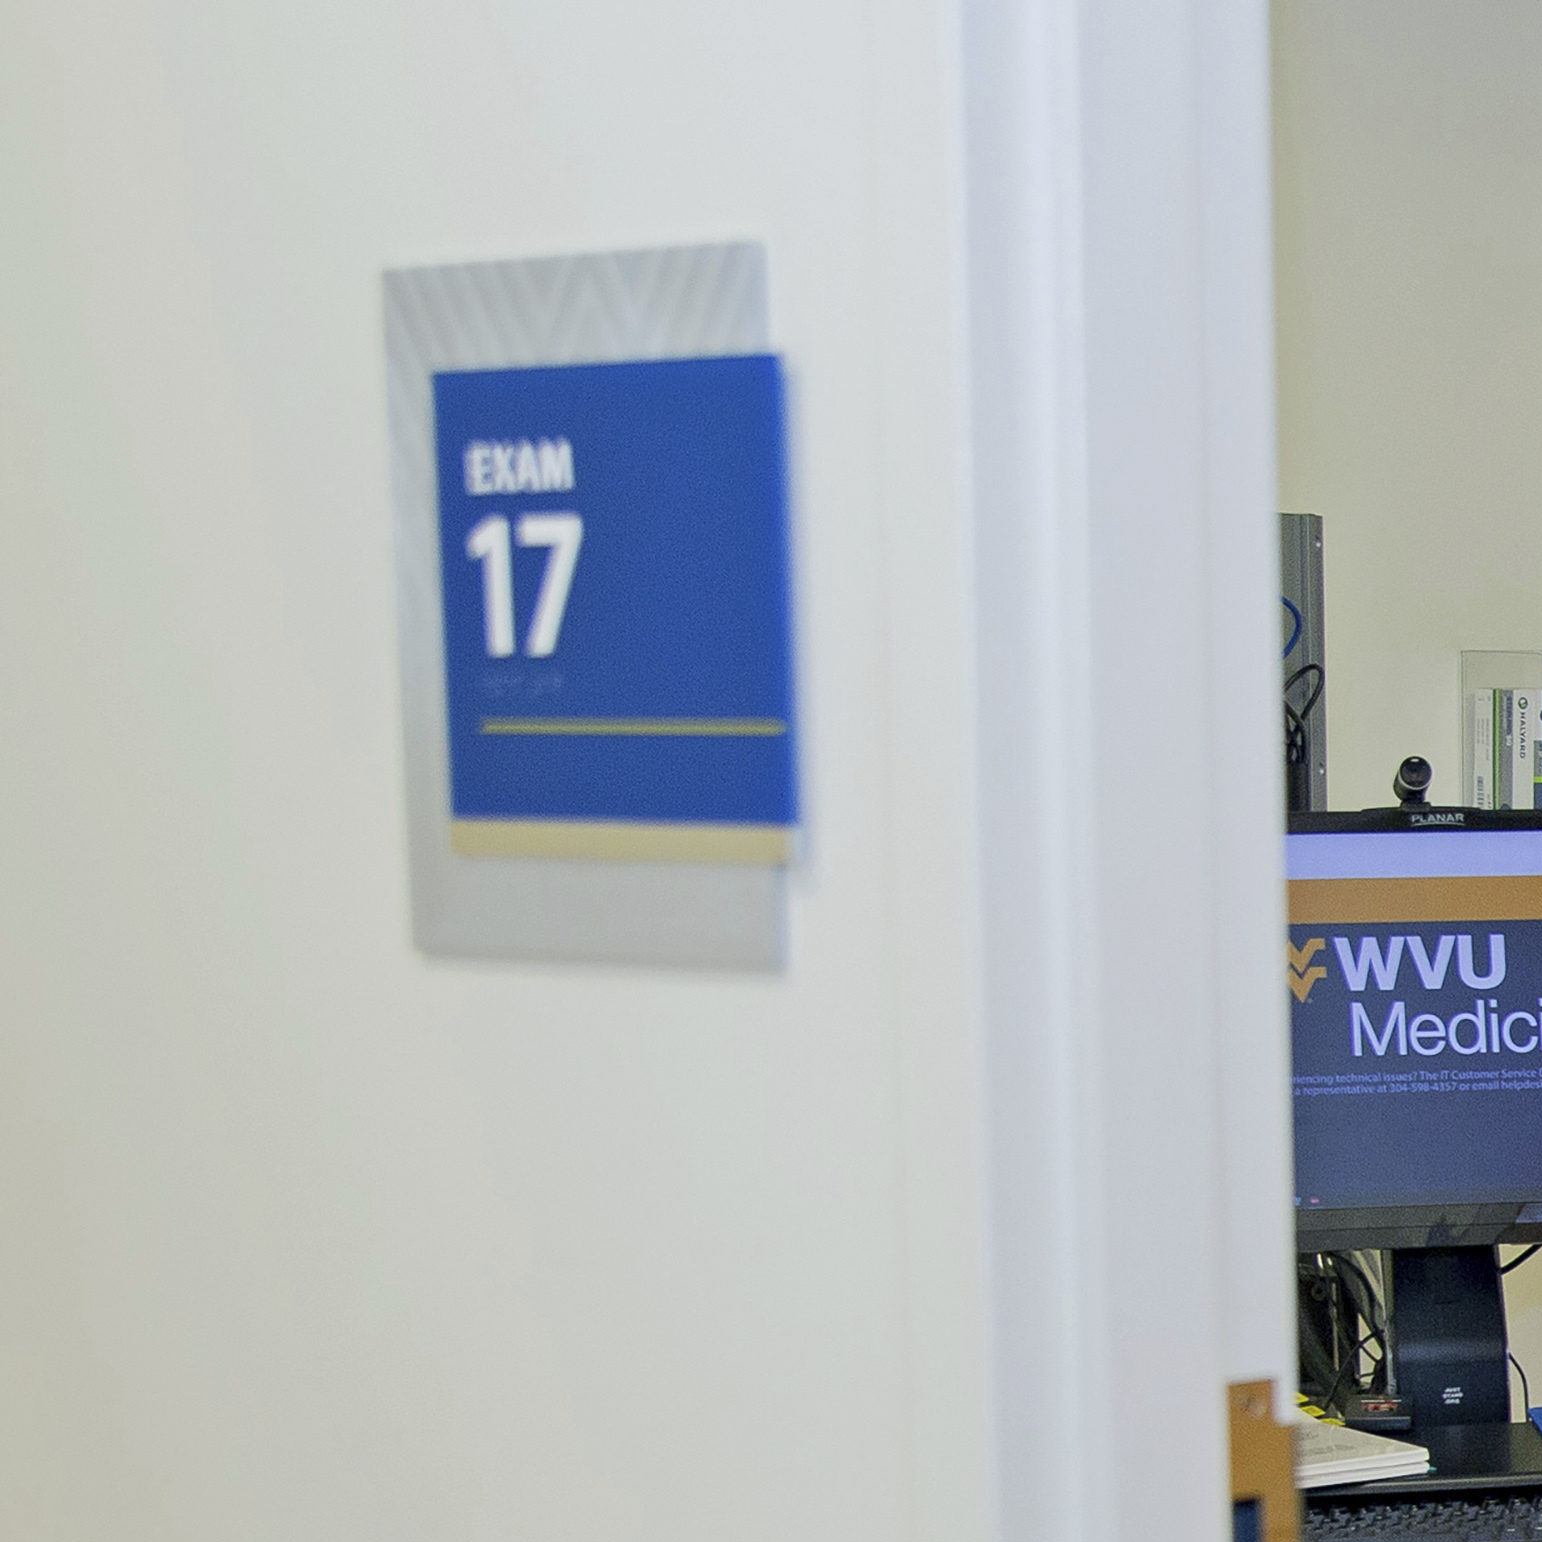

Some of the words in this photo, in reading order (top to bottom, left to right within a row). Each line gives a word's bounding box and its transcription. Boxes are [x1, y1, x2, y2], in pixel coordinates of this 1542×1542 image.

[465, 437, 574, 496] EXAM
[465, 513, 584, 658] 17
[1411, 813, 1465, 822] PLANAR
[1333, 933, 1508, 992] WVU
[1291, 1075, 1334, 1085] riencing
[1335, 1072, 1382, 1083] technical
[1383, 1071, 1417, 1082] issues?
[1419, 1071, 1439, 1081] The
[1440, 1070, 1450, 1080] IT
[1451, 1069, 1500, 1080] Customer
[1501, 1068, 1537, 1079] Service
[1303, 1084, 1375, 1096] representative
[1377, 1084, 1387, 1093] at
[1390, 1082, 1457, 1093] 304-598-4357
[1459, 1083, 1470, 1091] or
[1471, 1080, 1500, 1091] email
